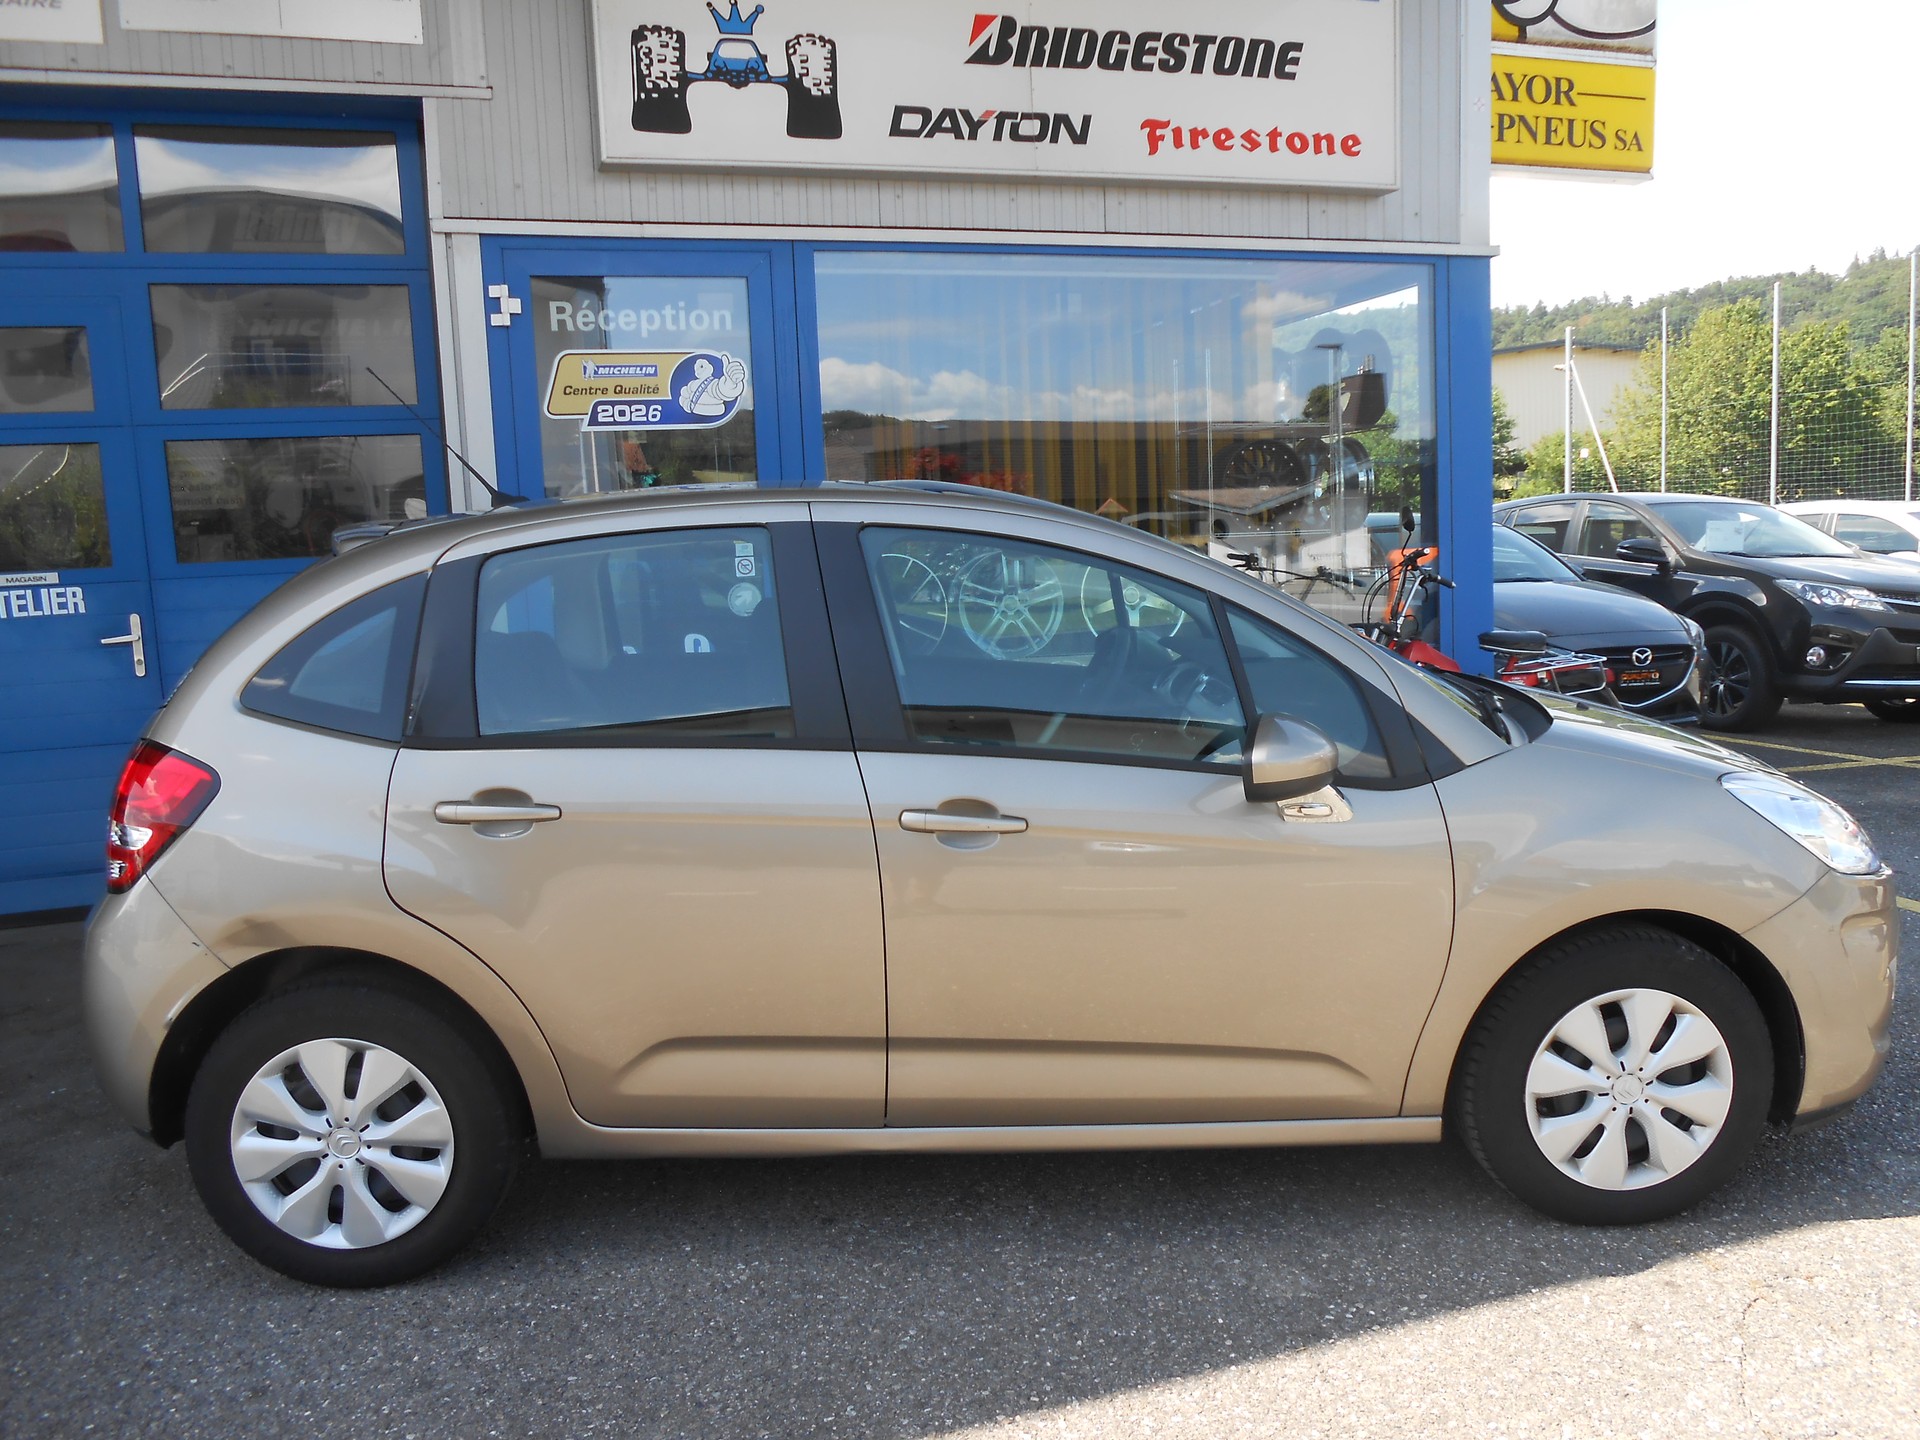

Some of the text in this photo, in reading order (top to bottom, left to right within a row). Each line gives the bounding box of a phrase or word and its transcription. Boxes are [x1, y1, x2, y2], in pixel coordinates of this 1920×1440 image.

[0, 0, 62, 9] AIRE
[964, 14, 1304, 80] BRIDGESTONE
[889, 105, 1092, 145] DAYTON
[1140, 118, 1362, 156] Firestone
[1614, 128, 1644, 152] SA
[549, 299, 732, 338] Réception
[598, 366, 656, 375] MICHELIN
[563, 384, 660, 396] Centre Qualité
[597, 405, 662, 422] 2026
[6, 575, 47, 584] MAGASIN
[0, 587, 85, 618] TELIER
